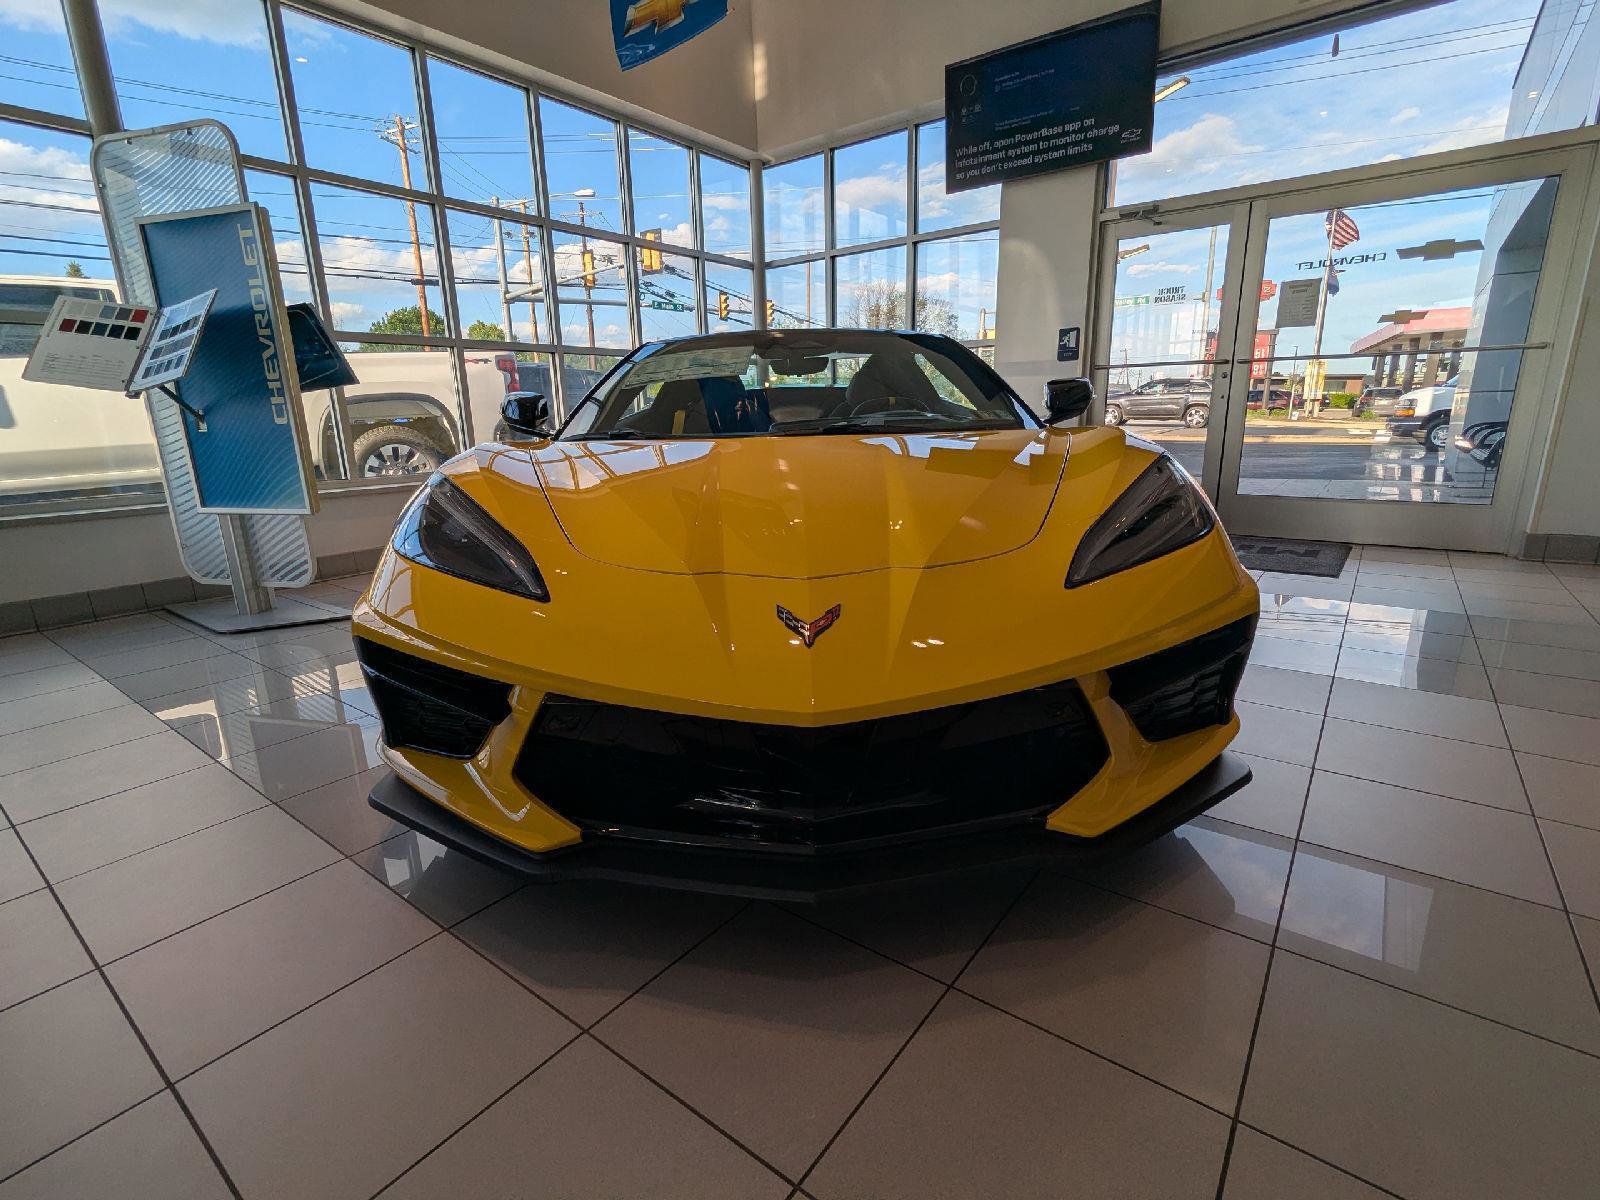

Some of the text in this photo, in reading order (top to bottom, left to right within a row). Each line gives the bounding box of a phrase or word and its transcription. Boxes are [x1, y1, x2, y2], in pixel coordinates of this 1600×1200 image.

[955, 118, 1095, 157] While off, open PowerBase app on
[955, 124, 1120, 168] infotainment system to monitor charge
[955, 172, 965, 180] so
[966, 168, 980, 178] you
[1003, 154, 1033, 169] exceed
[1034, 149, 1066, 164] system
[1067, 143, 1093, 155] limits
[237, 223, 288, 425] CHEVROLET
